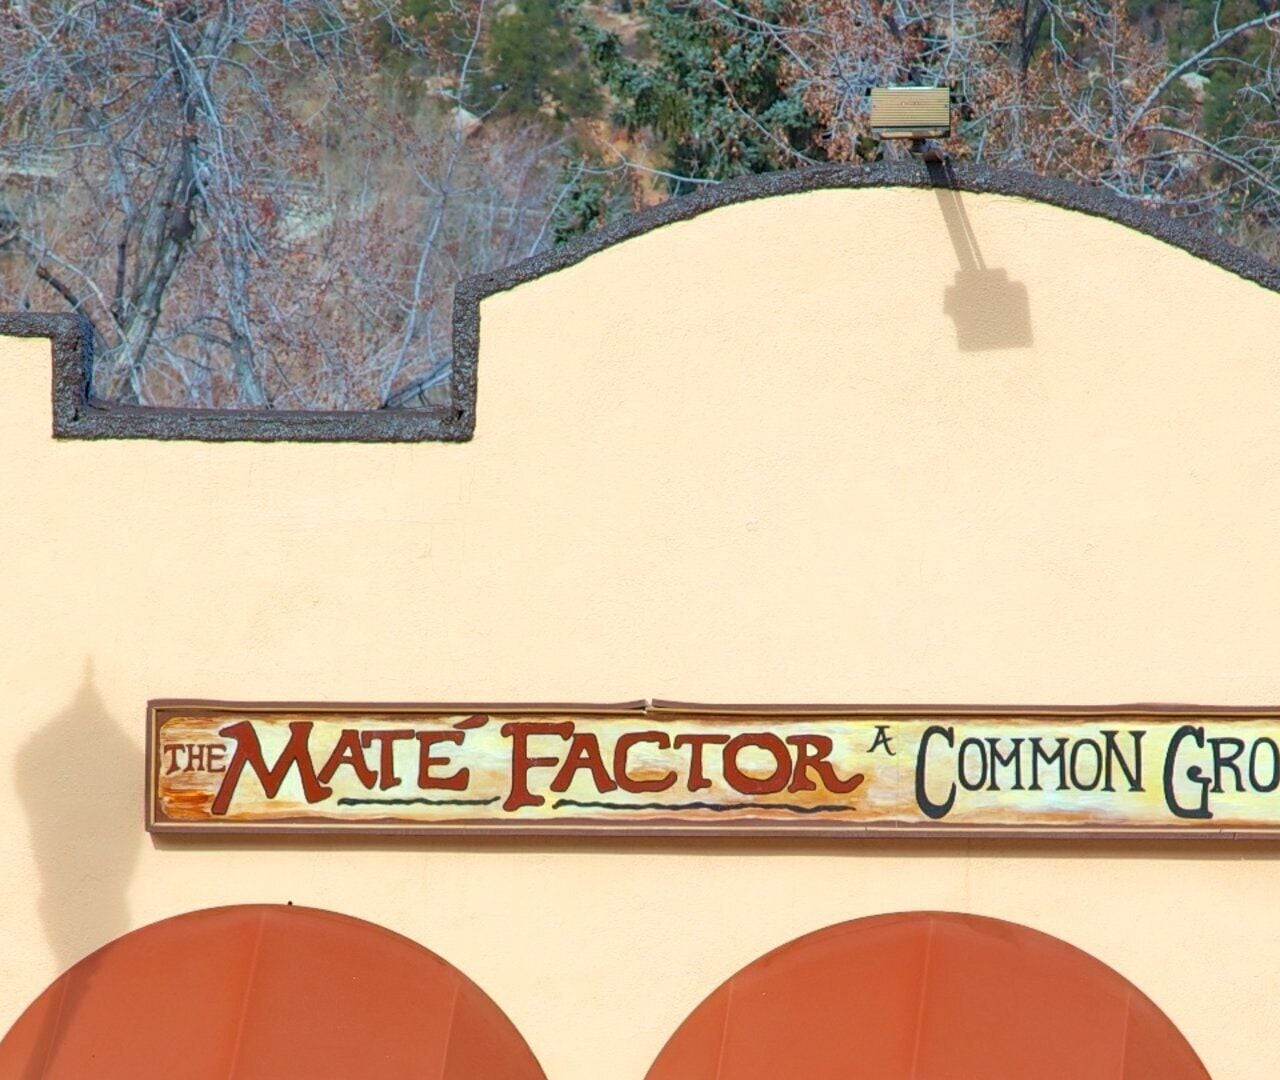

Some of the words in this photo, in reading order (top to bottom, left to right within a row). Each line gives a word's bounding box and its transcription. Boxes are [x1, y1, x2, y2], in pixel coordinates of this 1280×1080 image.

[502, 722, 864, 811] FACTOR
[867, 725, 897, 755] A
[916, 726, 1144, 819] COMMON
